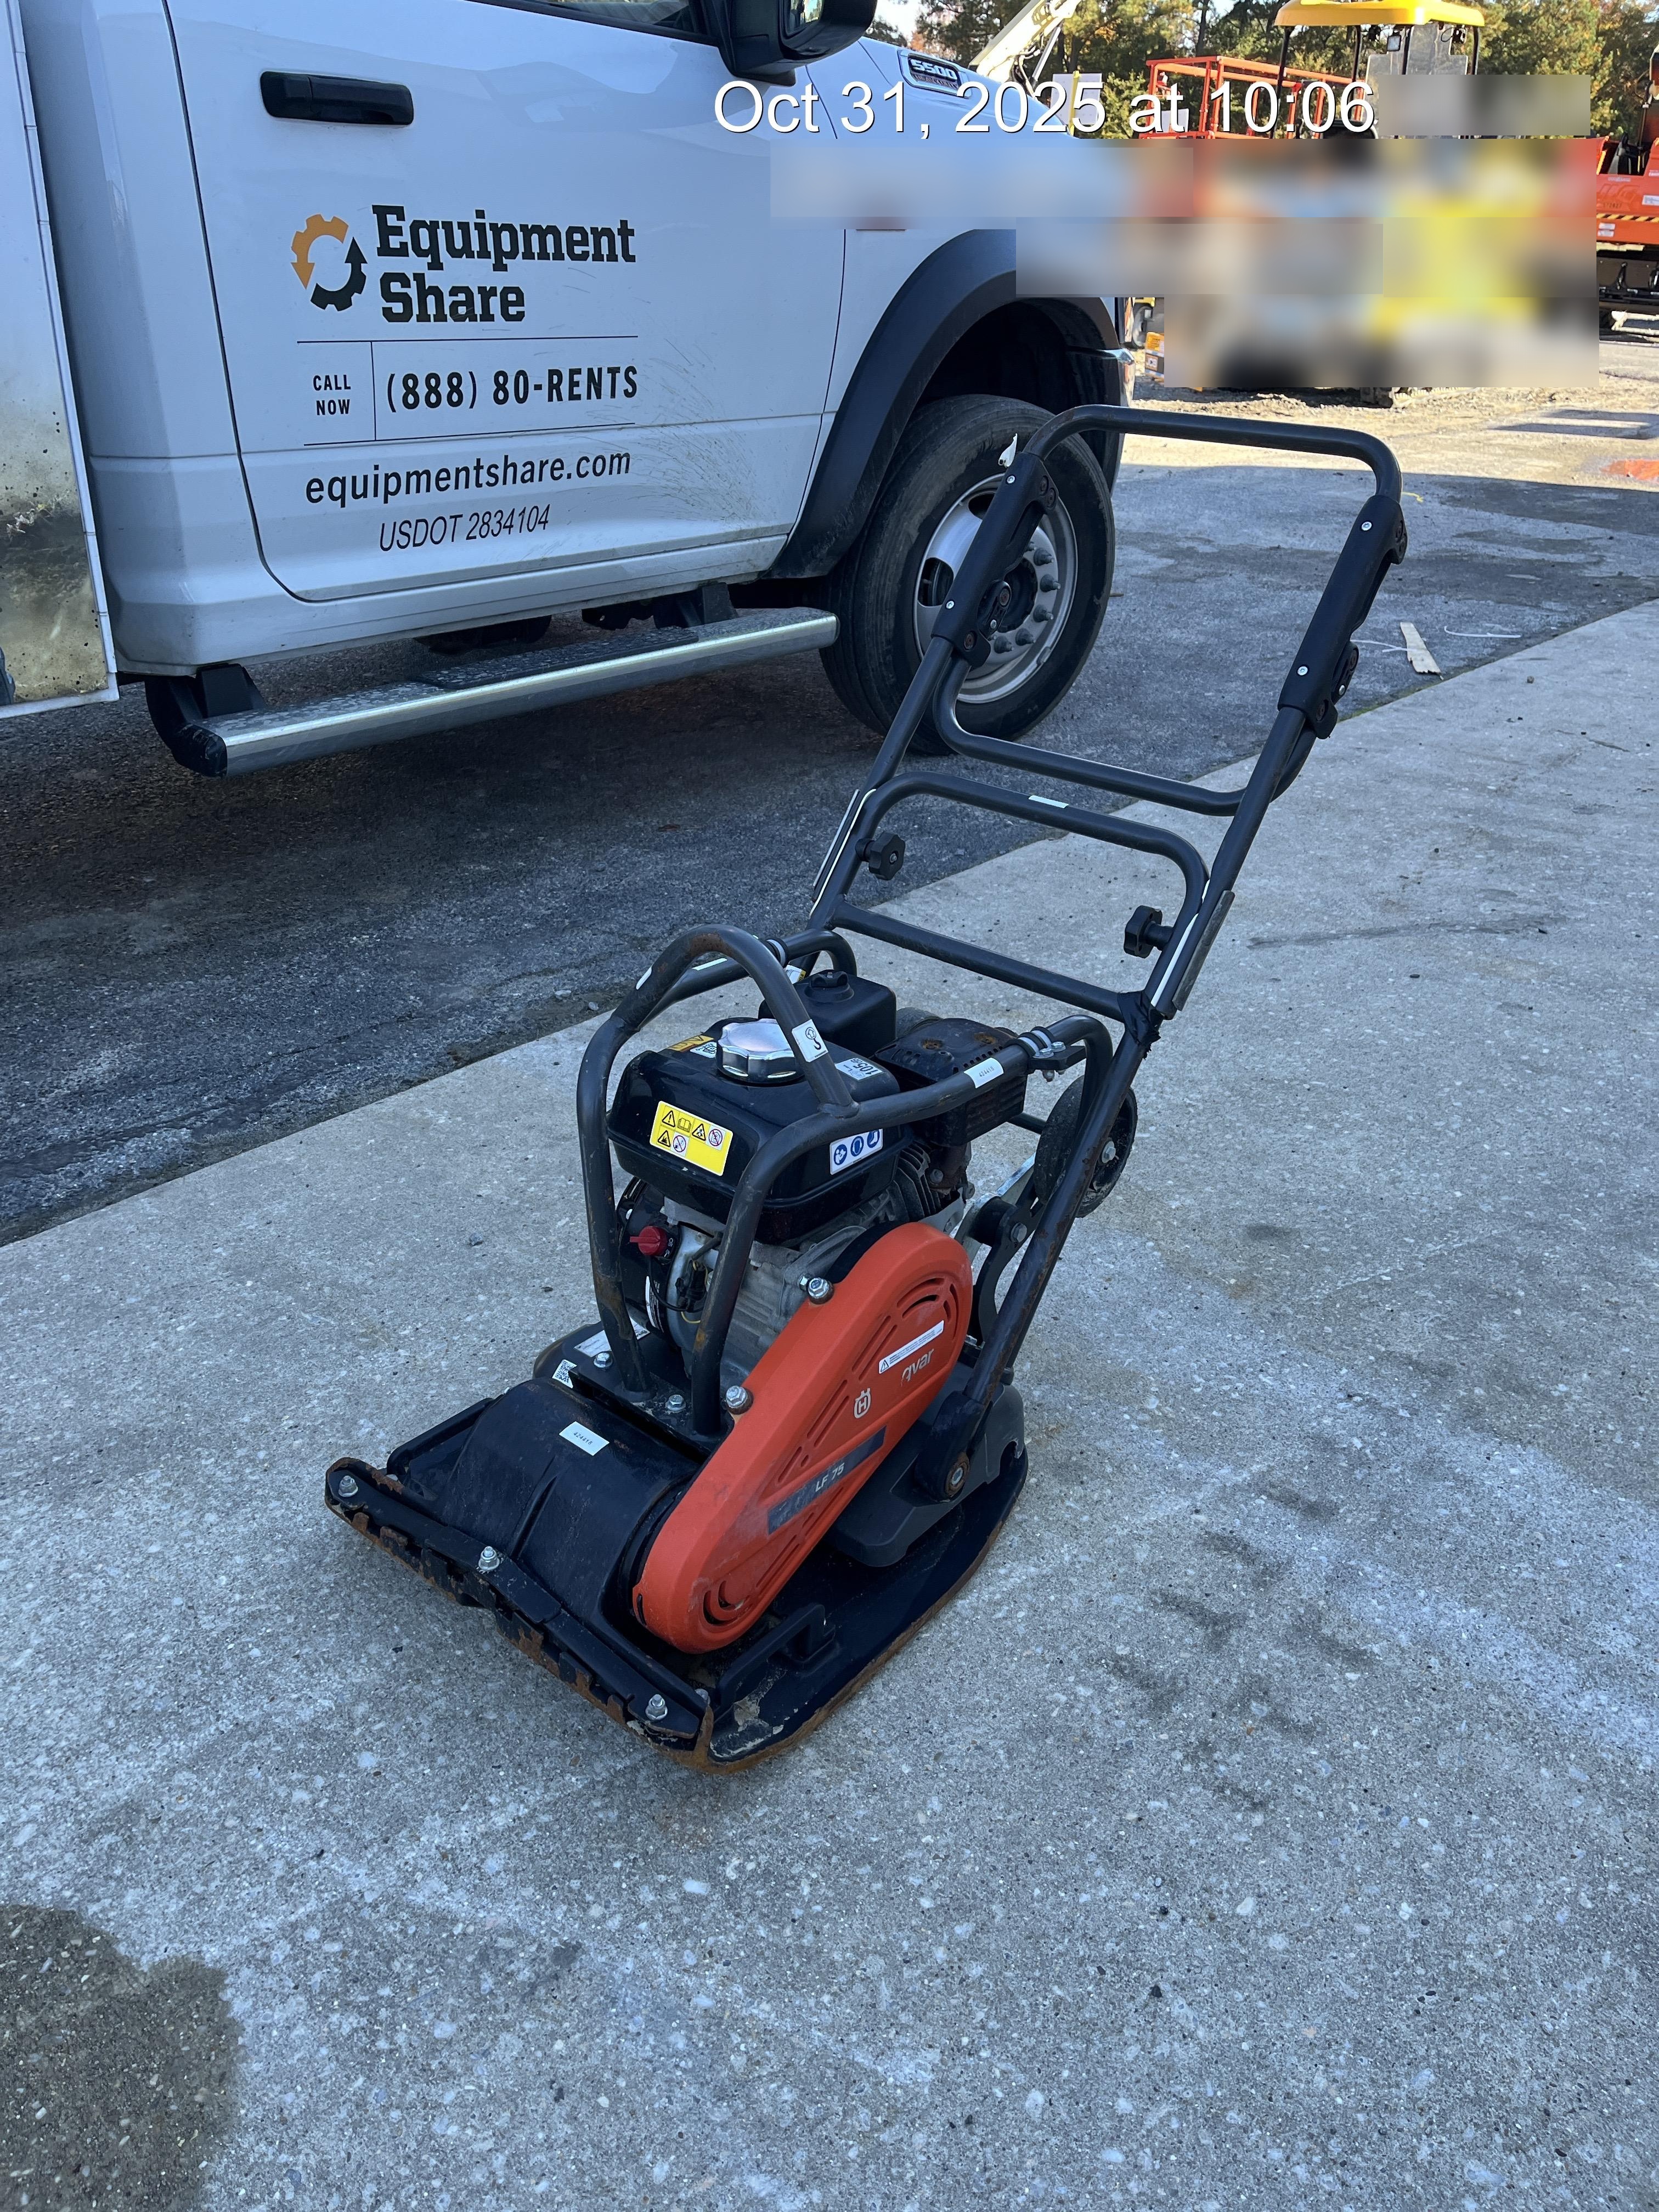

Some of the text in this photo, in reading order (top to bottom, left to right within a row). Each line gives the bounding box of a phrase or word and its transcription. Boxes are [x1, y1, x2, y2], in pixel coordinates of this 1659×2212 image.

[910, 59, 958, 80] 5500
[372, 205, 636, 272] Equipment
[380, 272, 526, 323] Share
[313, 374, 351, 391] CALL
[387, 365, 637, 413] (888) 80-RENTS
[316, 399, 350, 416] NOW
[306, 452, 631, 508] equipmentshare.com
[380, 504, 551, 551] USDOT 2834104
[815, 1462, 845, 1492] LF 75
